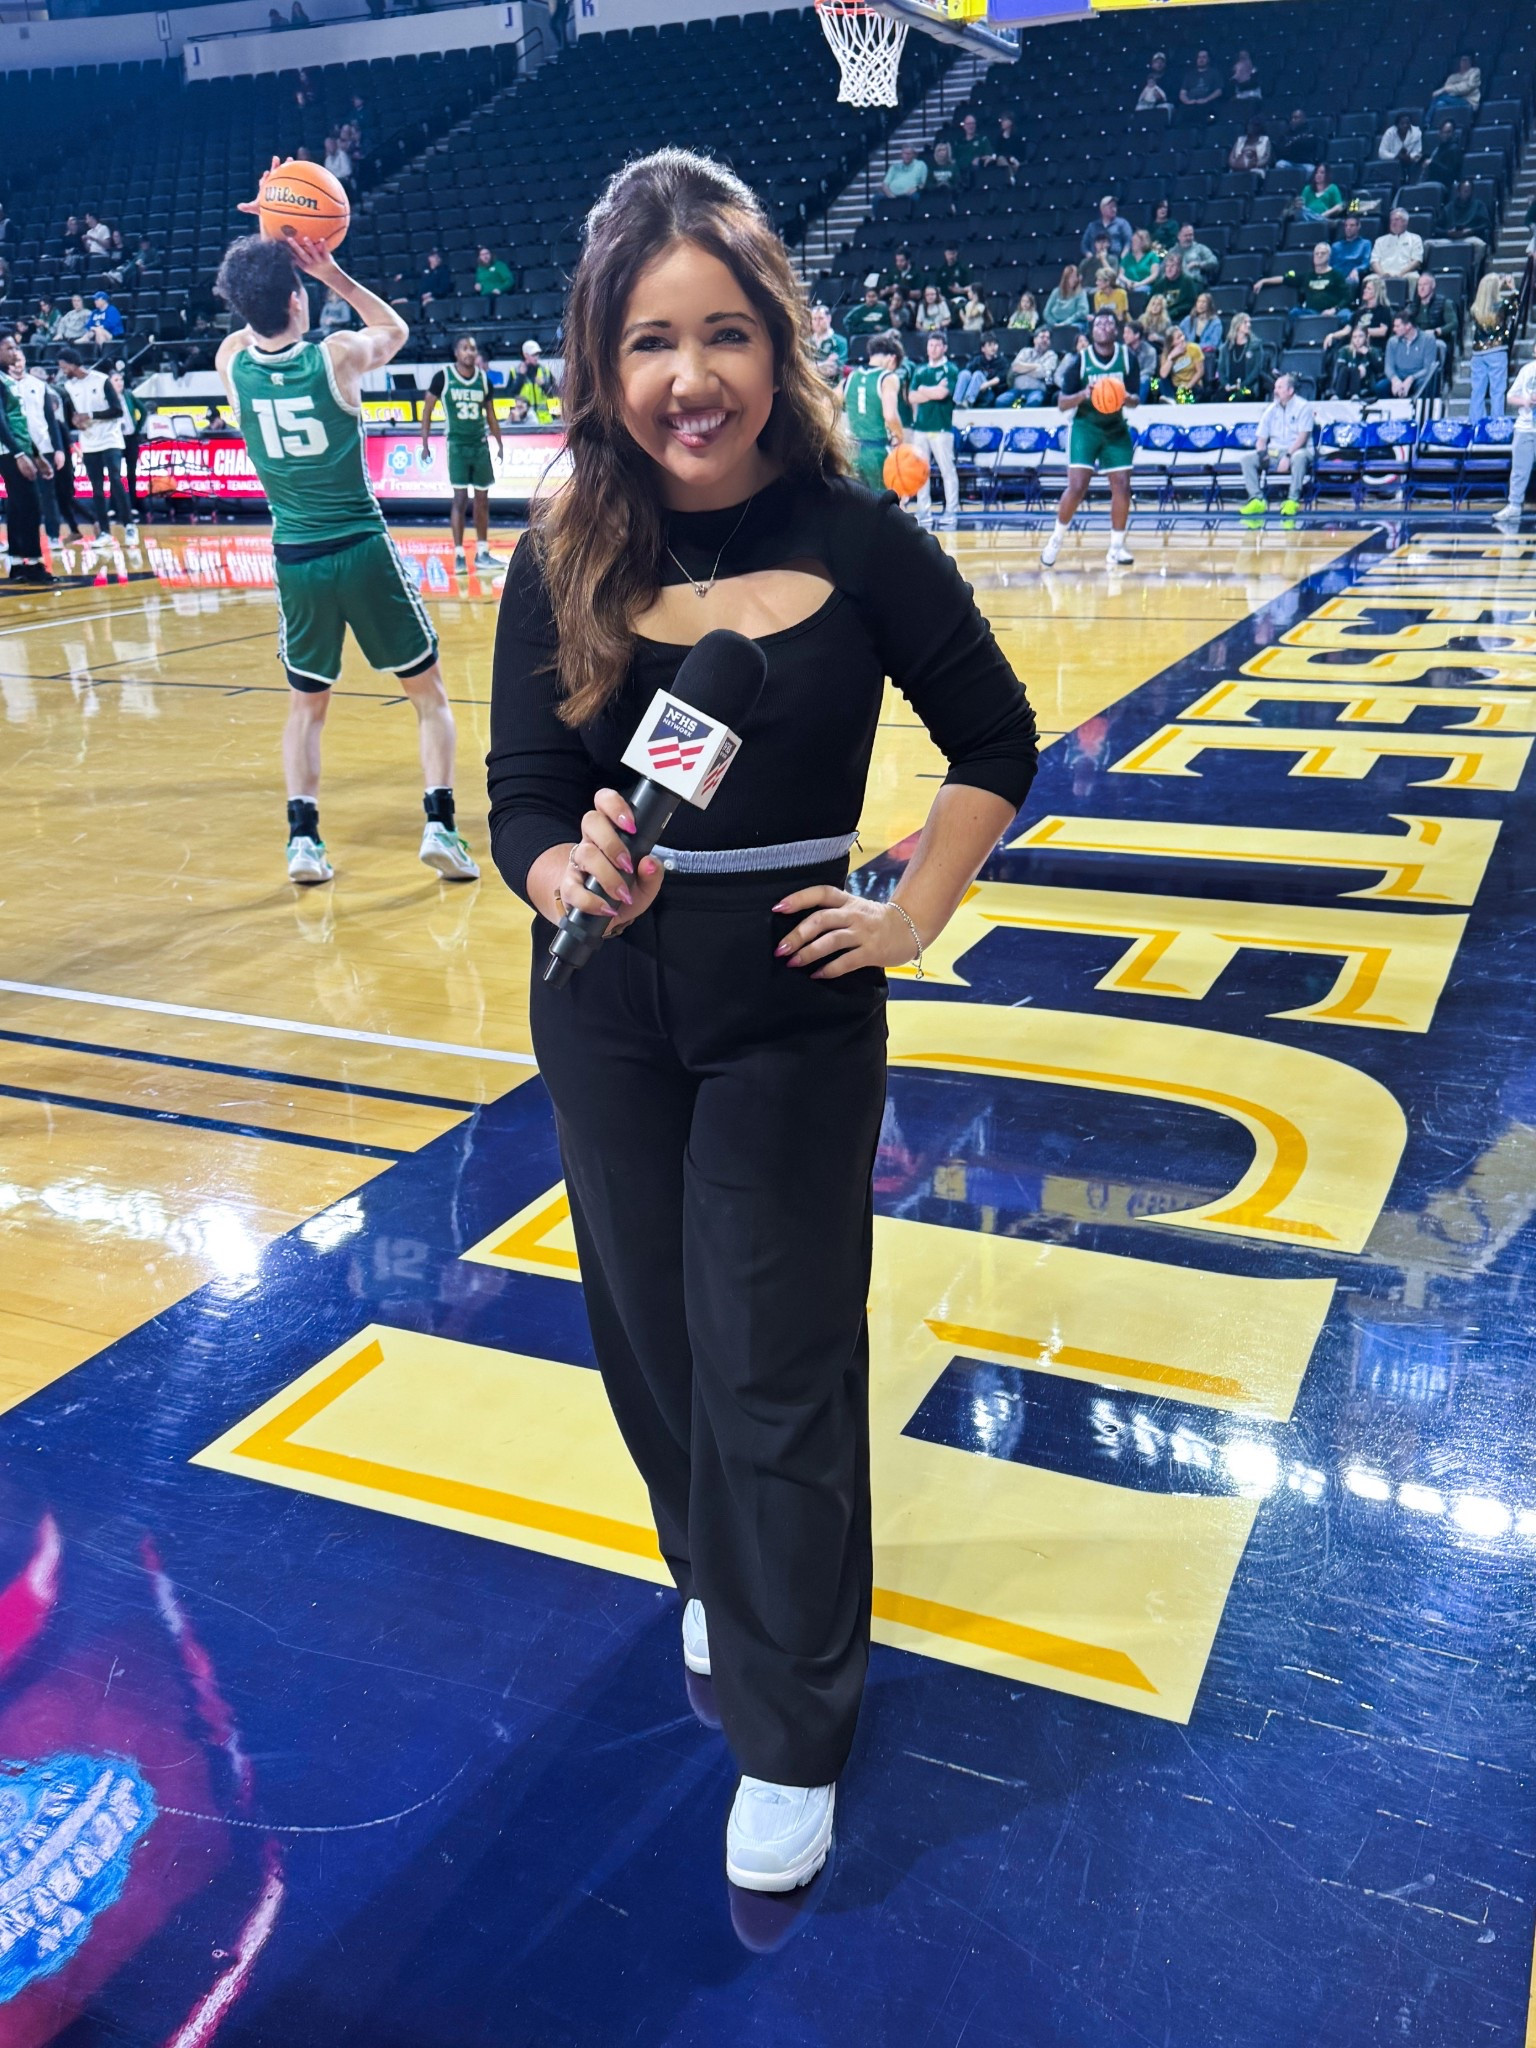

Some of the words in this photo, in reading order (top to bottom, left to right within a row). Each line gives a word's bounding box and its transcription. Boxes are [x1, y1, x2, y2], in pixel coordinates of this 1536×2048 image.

[505, 7, 513, 27] J
[264, 186, 319, 210] Wilson
[455, 401, 479, 420] 33
[857, 387, 867, 414] 1
[251, 395, 330, 459] 15
[662, 717, 693, 738] NETWORK
[665, 707, 698, 732] NFHS
